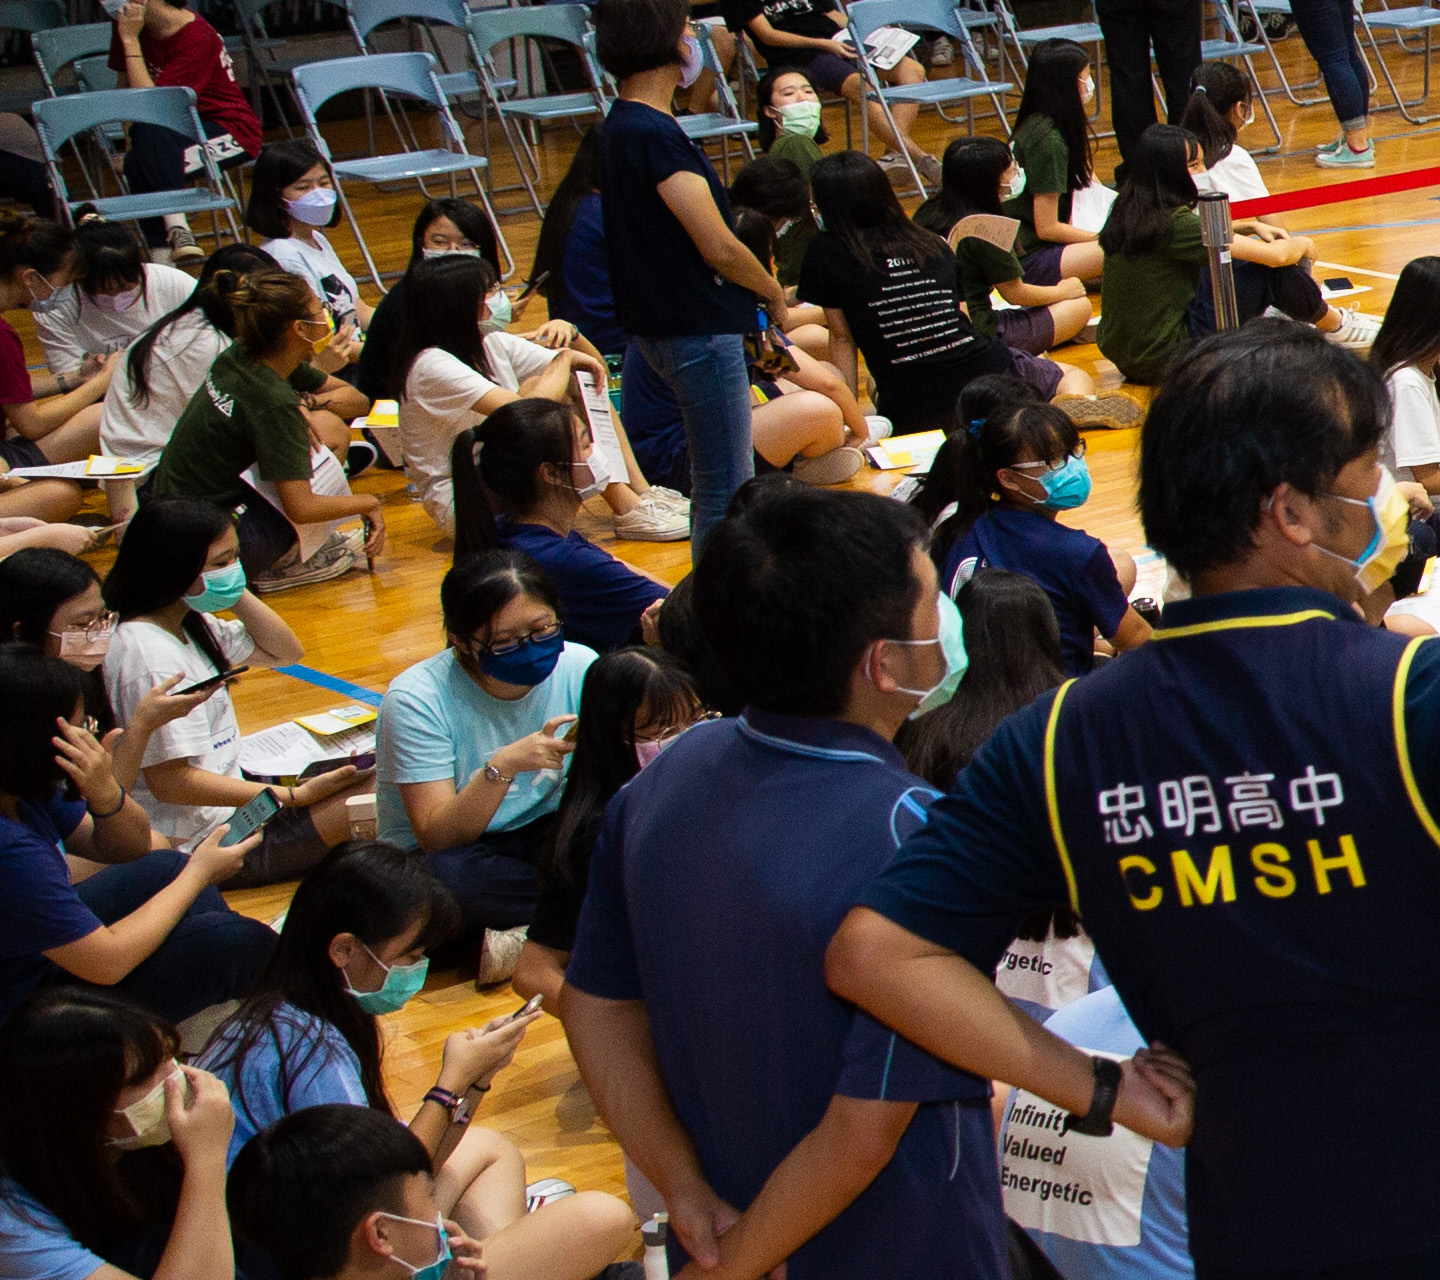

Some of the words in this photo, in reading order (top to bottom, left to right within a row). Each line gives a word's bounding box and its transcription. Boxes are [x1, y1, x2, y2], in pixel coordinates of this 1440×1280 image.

[1098, 765, 1345, 844] 忠明高中
[1119, 834, 1367, 910] CMSH
[1002, 948, 1053, 976] rgetic
[1008, 1102, 1072, 1138] Infinity
[1002, 1134, 1066, 1166] Valued
[1000, 1168, 1093, 1206] Energetic
